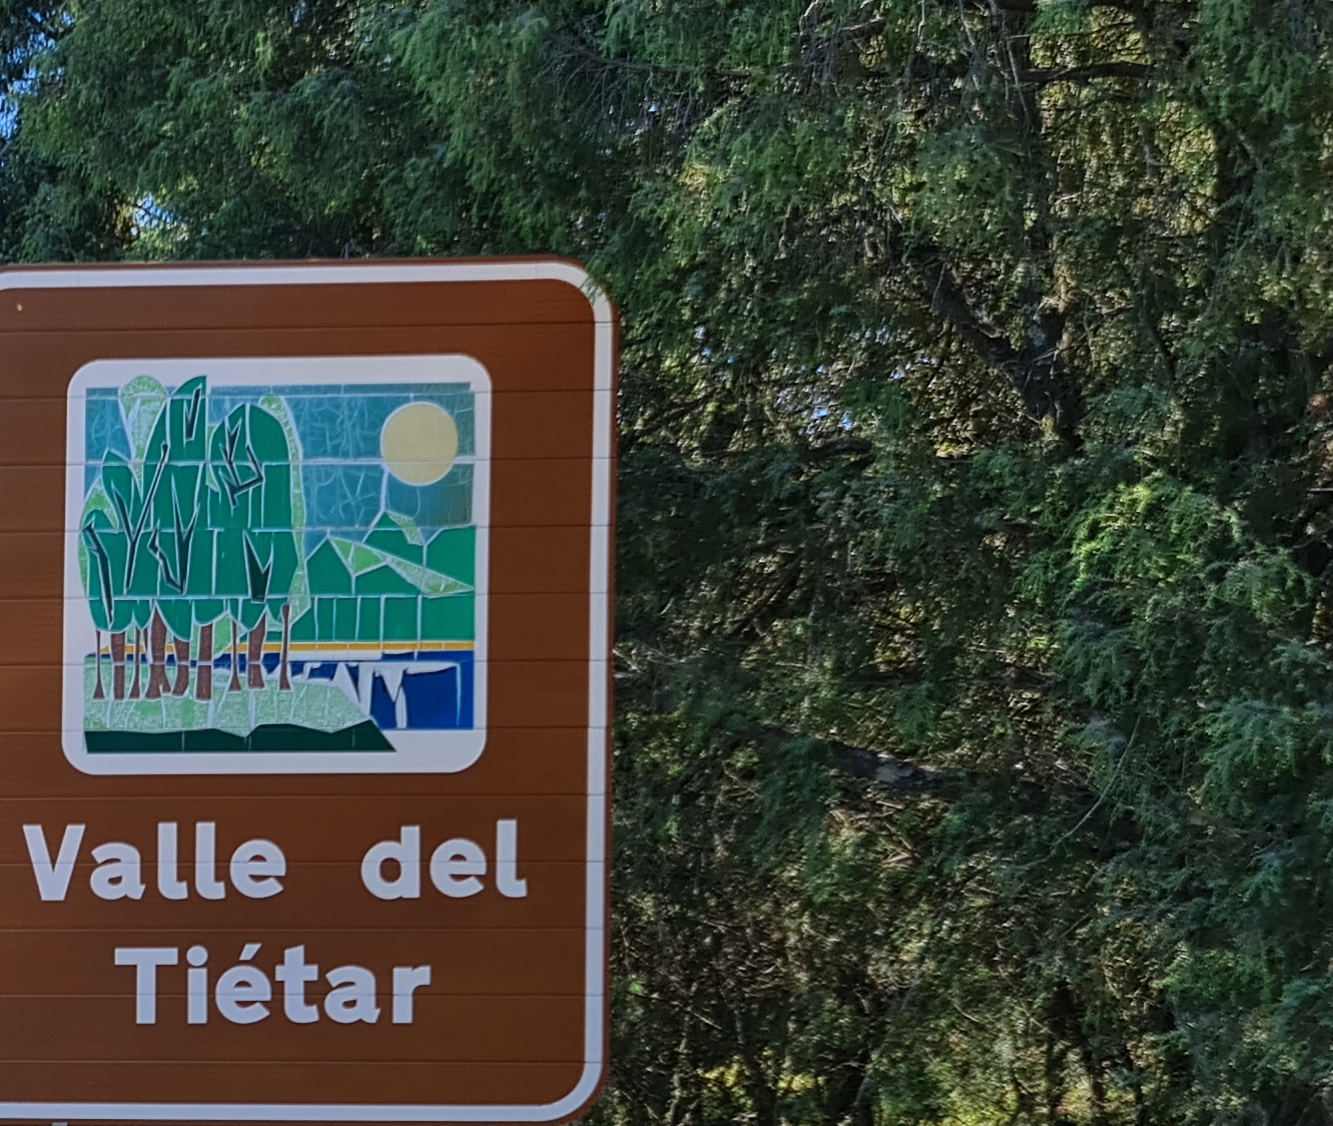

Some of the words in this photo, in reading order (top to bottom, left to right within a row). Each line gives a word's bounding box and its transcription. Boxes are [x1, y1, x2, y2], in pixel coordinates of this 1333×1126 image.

[22, 821, 287, 901] Valle
[360, 818, 528, 900] del
[114, 943, 432, 1025] Tiétar
